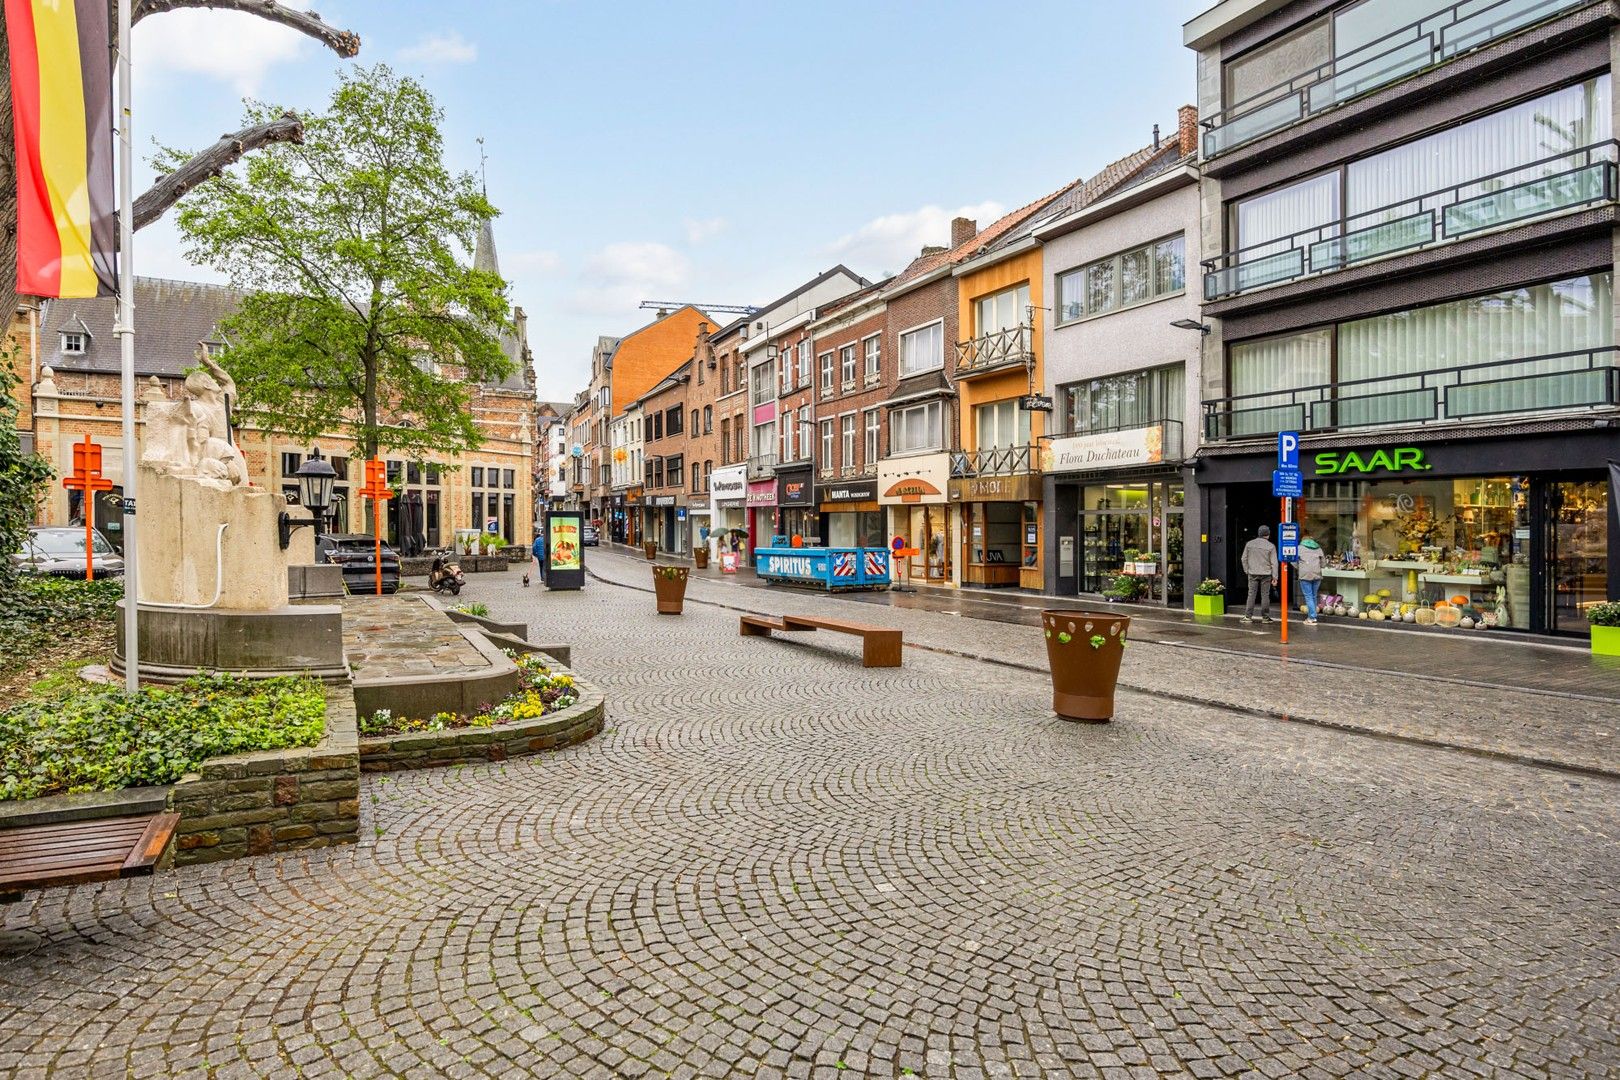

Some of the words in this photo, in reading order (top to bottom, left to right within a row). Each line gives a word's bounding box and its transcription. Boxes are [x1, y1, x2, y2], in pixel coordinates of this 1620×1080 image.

[1060, 452, 1083, 465] Flora
[1086, 447, 1141, 463] Duchateau
[1282, 435, 1296, 462] P
[1314, 447, 1433, 475] SAAR.
[769, 556, 811, 576] SPIRITUS
